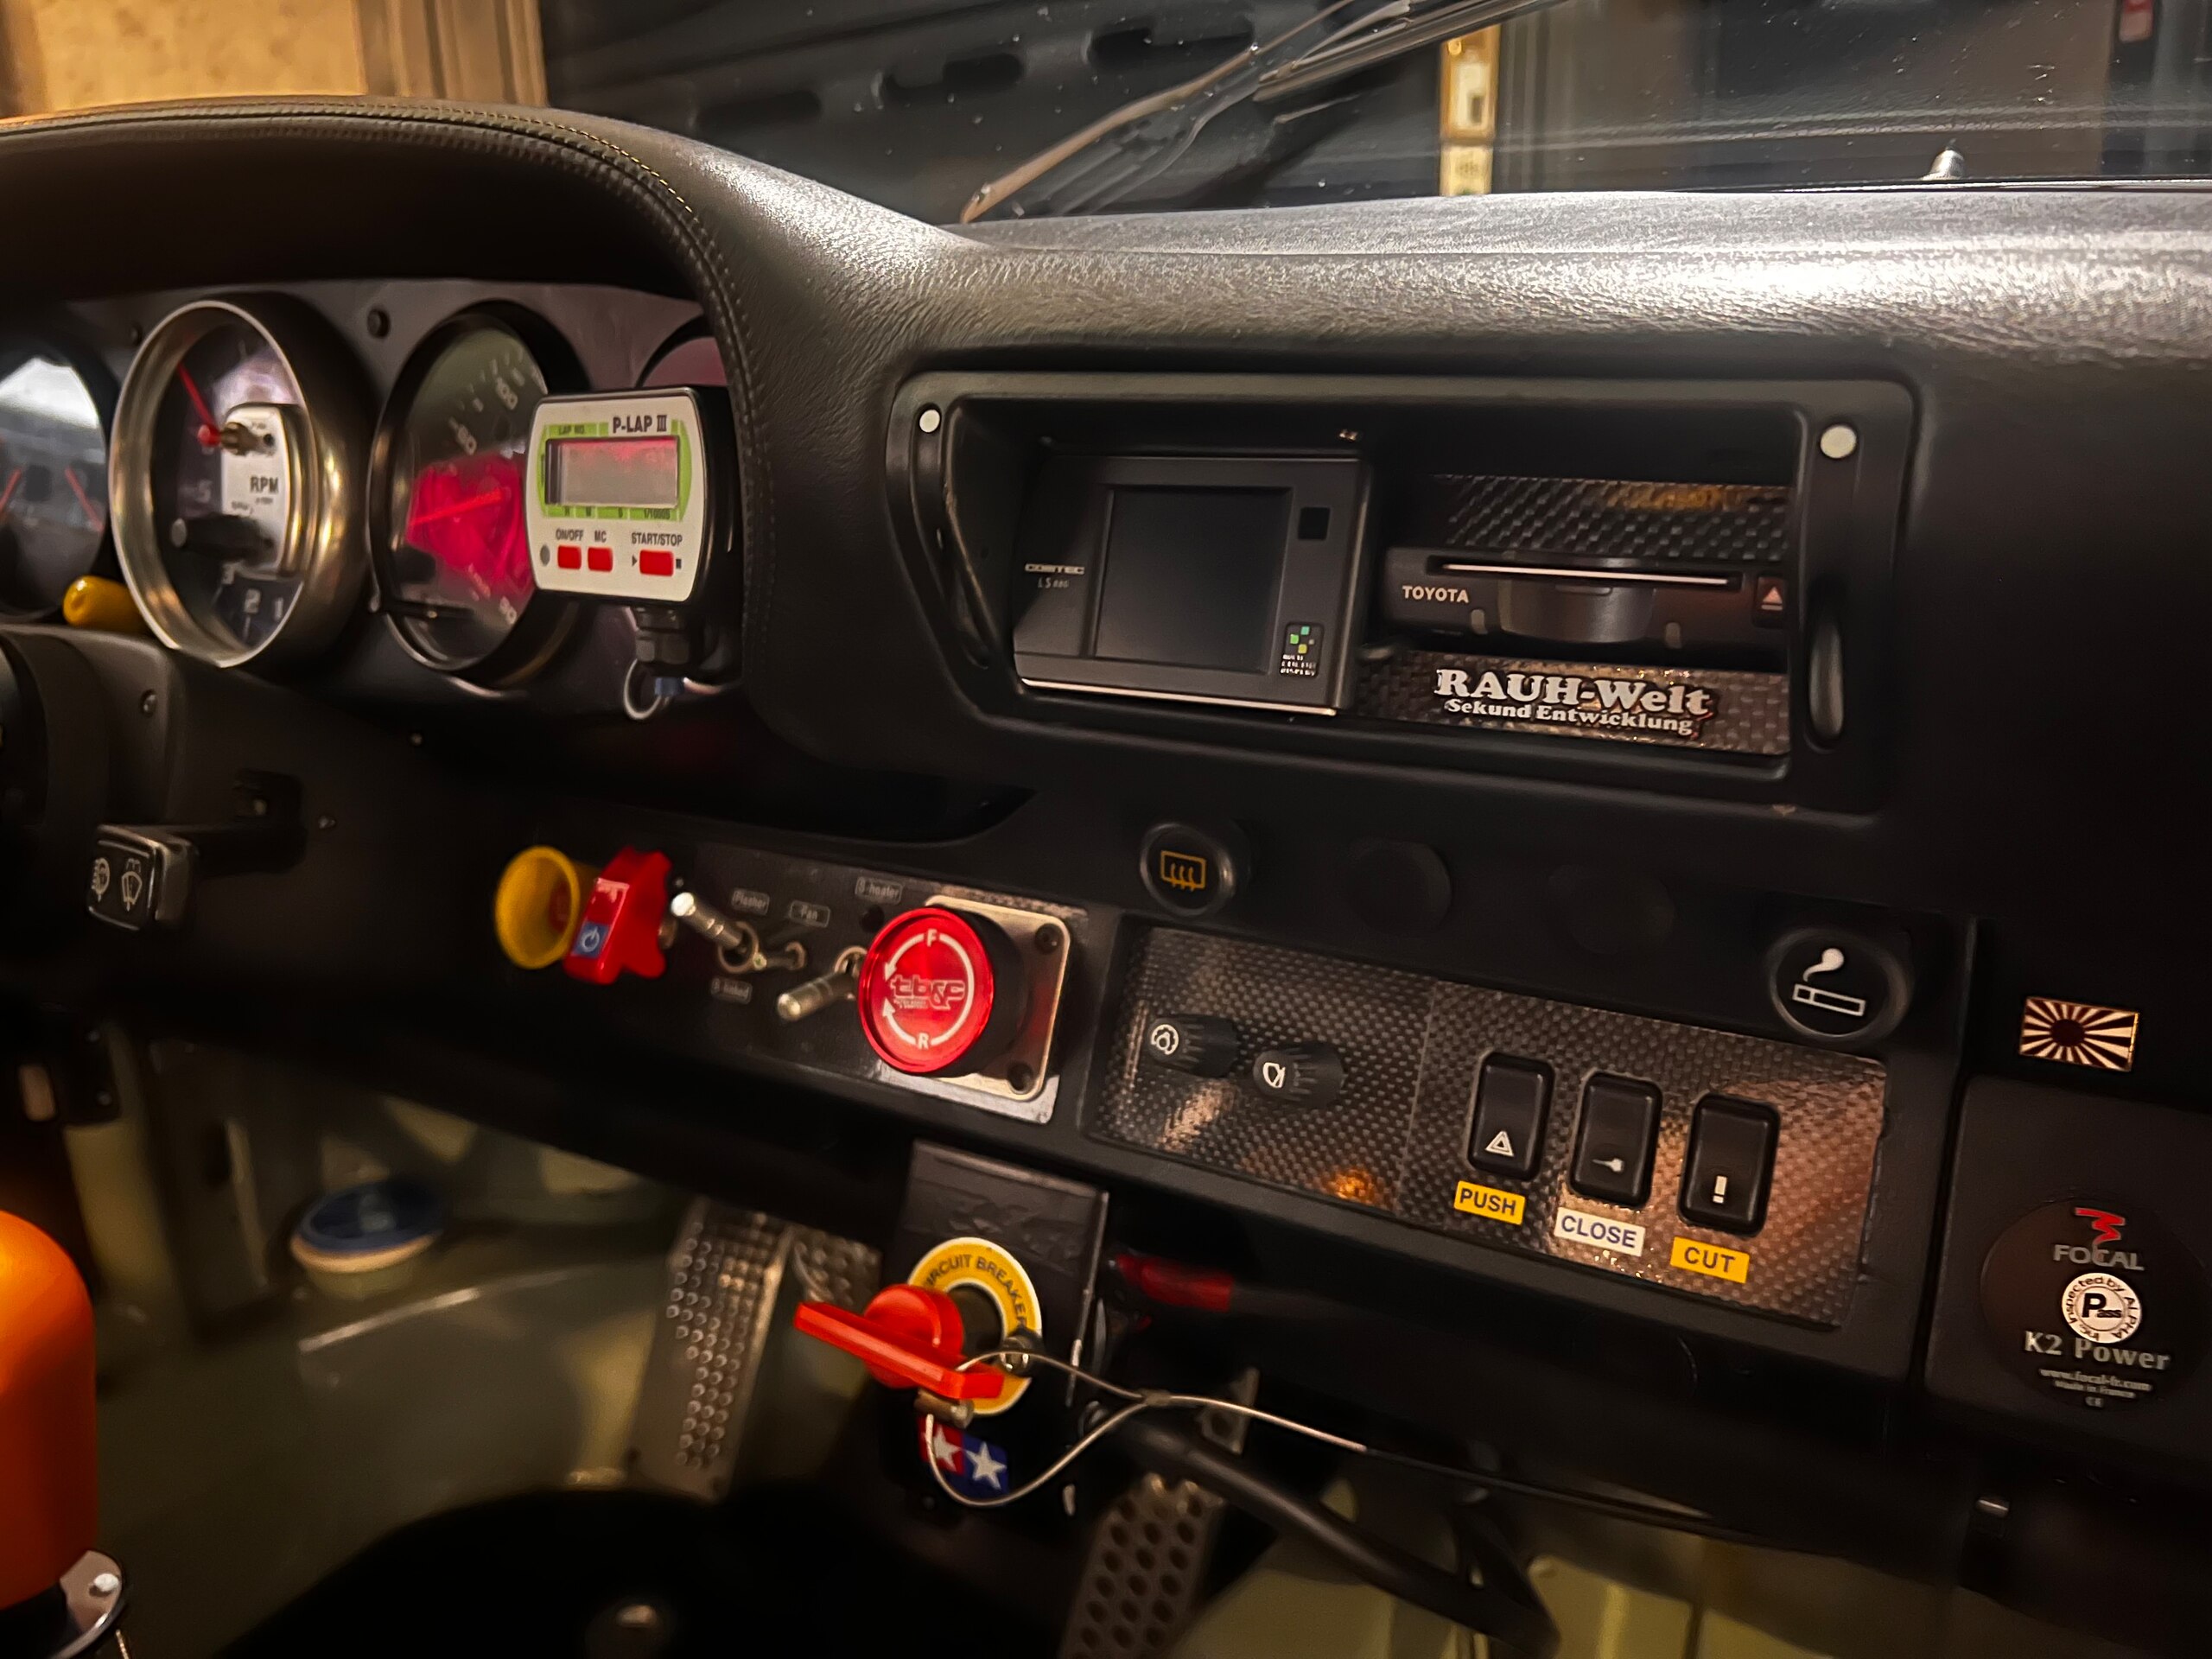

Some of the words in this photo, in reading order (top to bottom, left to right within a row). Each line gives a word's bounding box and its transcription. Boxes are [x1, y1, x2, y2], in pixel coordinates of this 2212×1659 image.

[613, 416, 652, 434] P-LAP
[250, 476, 279, 493] RPM
[556, 529, 584, 540] ON/OFF
[594, 531, 607, 543] MC
[631, 532, 683, 546] START/STOP
[1402, 585, 1470, 604] TOYOTA
[1434, 668, 1711, 716] RAUH-Welt
[1444, 698, 1532, 720] Sekund
[1535, 706, 1694, 736] Entwicklung
[927, 928, 938, 947] F
[918, 1033, 930, 1049] R
[1460, 1189, 1516, 1217] PUSH
[1560, 1215, 1638, 1249] CLOSE
[1684, 1247, 1735, 1273] CUT
[2053, 1244, 2145, 1271] FOCAL
[925, 1255, 971, 1286] IRCUIT
[2024, 1331, 2063, 1356] K2
[2075, 1337, 2171, 1370] Power
